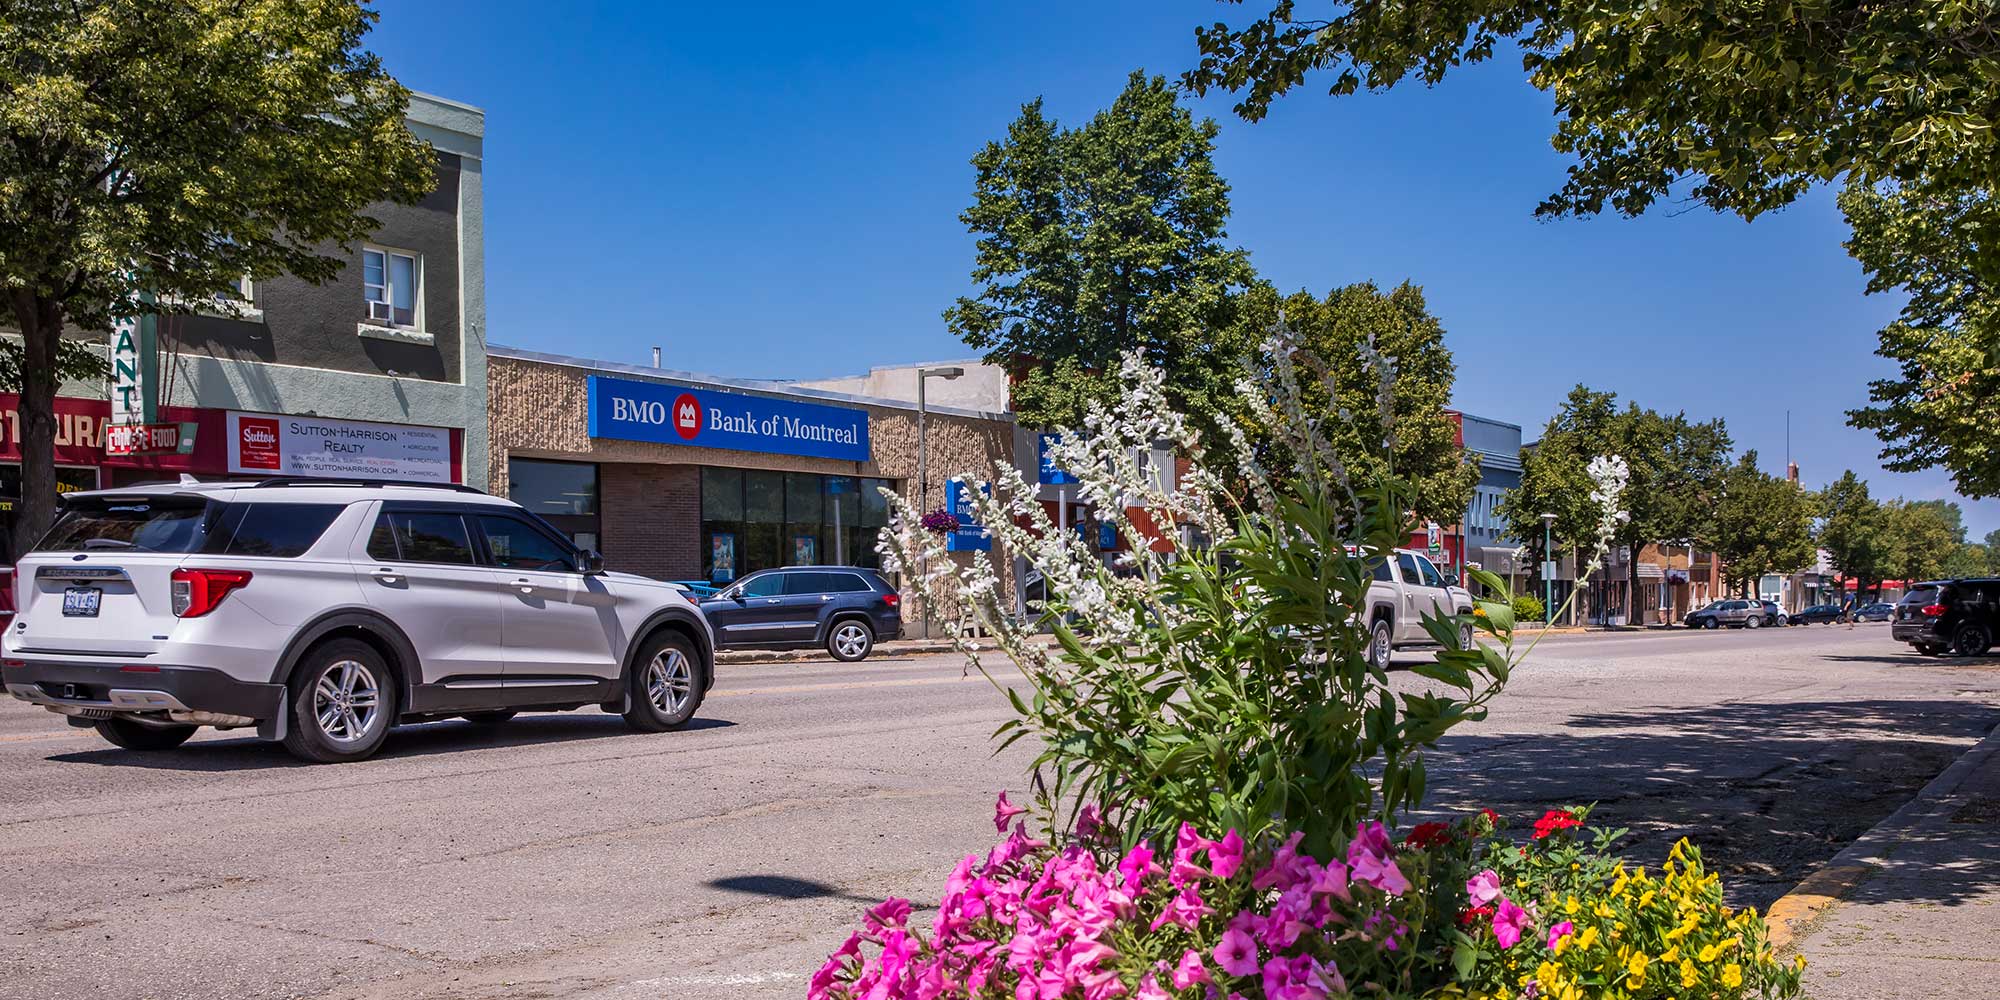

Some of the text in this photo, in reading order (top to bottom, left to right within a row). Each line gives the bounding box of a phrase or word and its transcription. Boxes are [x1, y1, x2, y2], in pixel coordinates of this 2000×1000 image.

[611, 397, 858, 445] BMO Bank of Montreal
[151, 428, 177, 448] FOOD
[243, 427, 276, 443] Sutton
